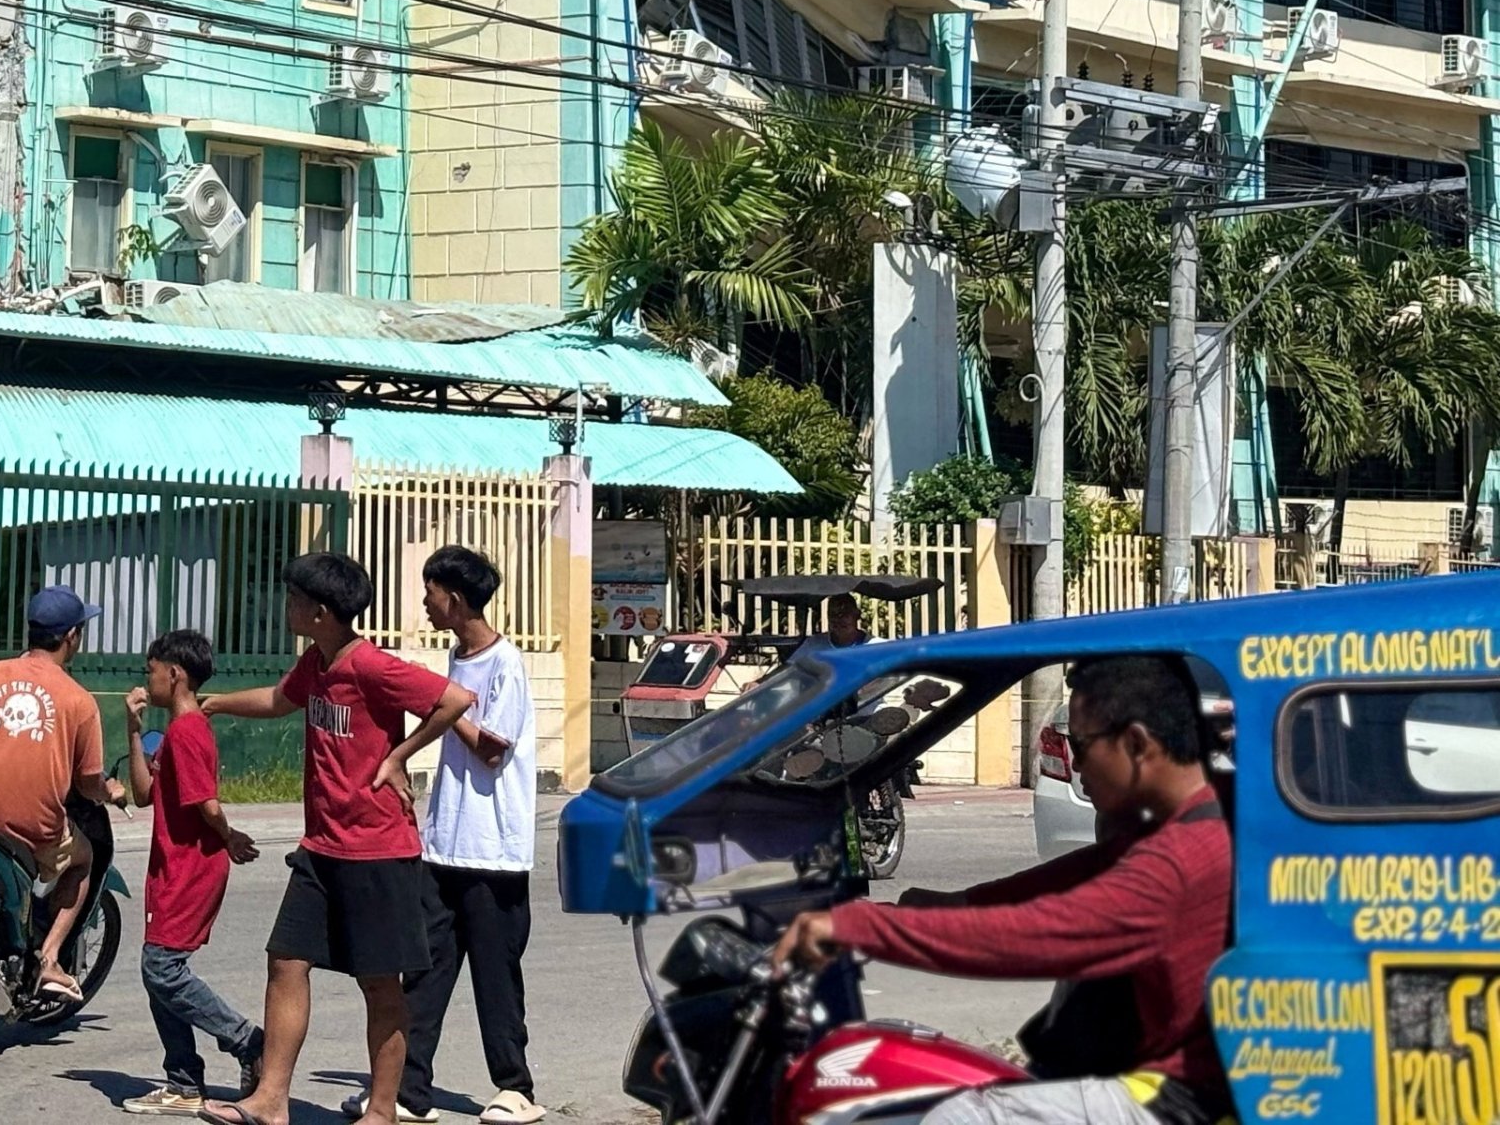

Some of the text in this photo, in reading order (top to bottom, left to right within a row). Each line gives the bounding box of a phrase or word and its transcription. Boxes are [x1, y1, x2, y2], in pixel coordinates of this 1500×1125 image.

[1240, 633, 1337, 679] EXCEPT
[1340, 630, 1427, 674] ALONG
[11, 681, 33, 692] THE
[1270, 856, 1337, 904] MTOP
[816, 1077, 878, 1088] HONDA
[1257, 1092, 1322, 1119] GSC
